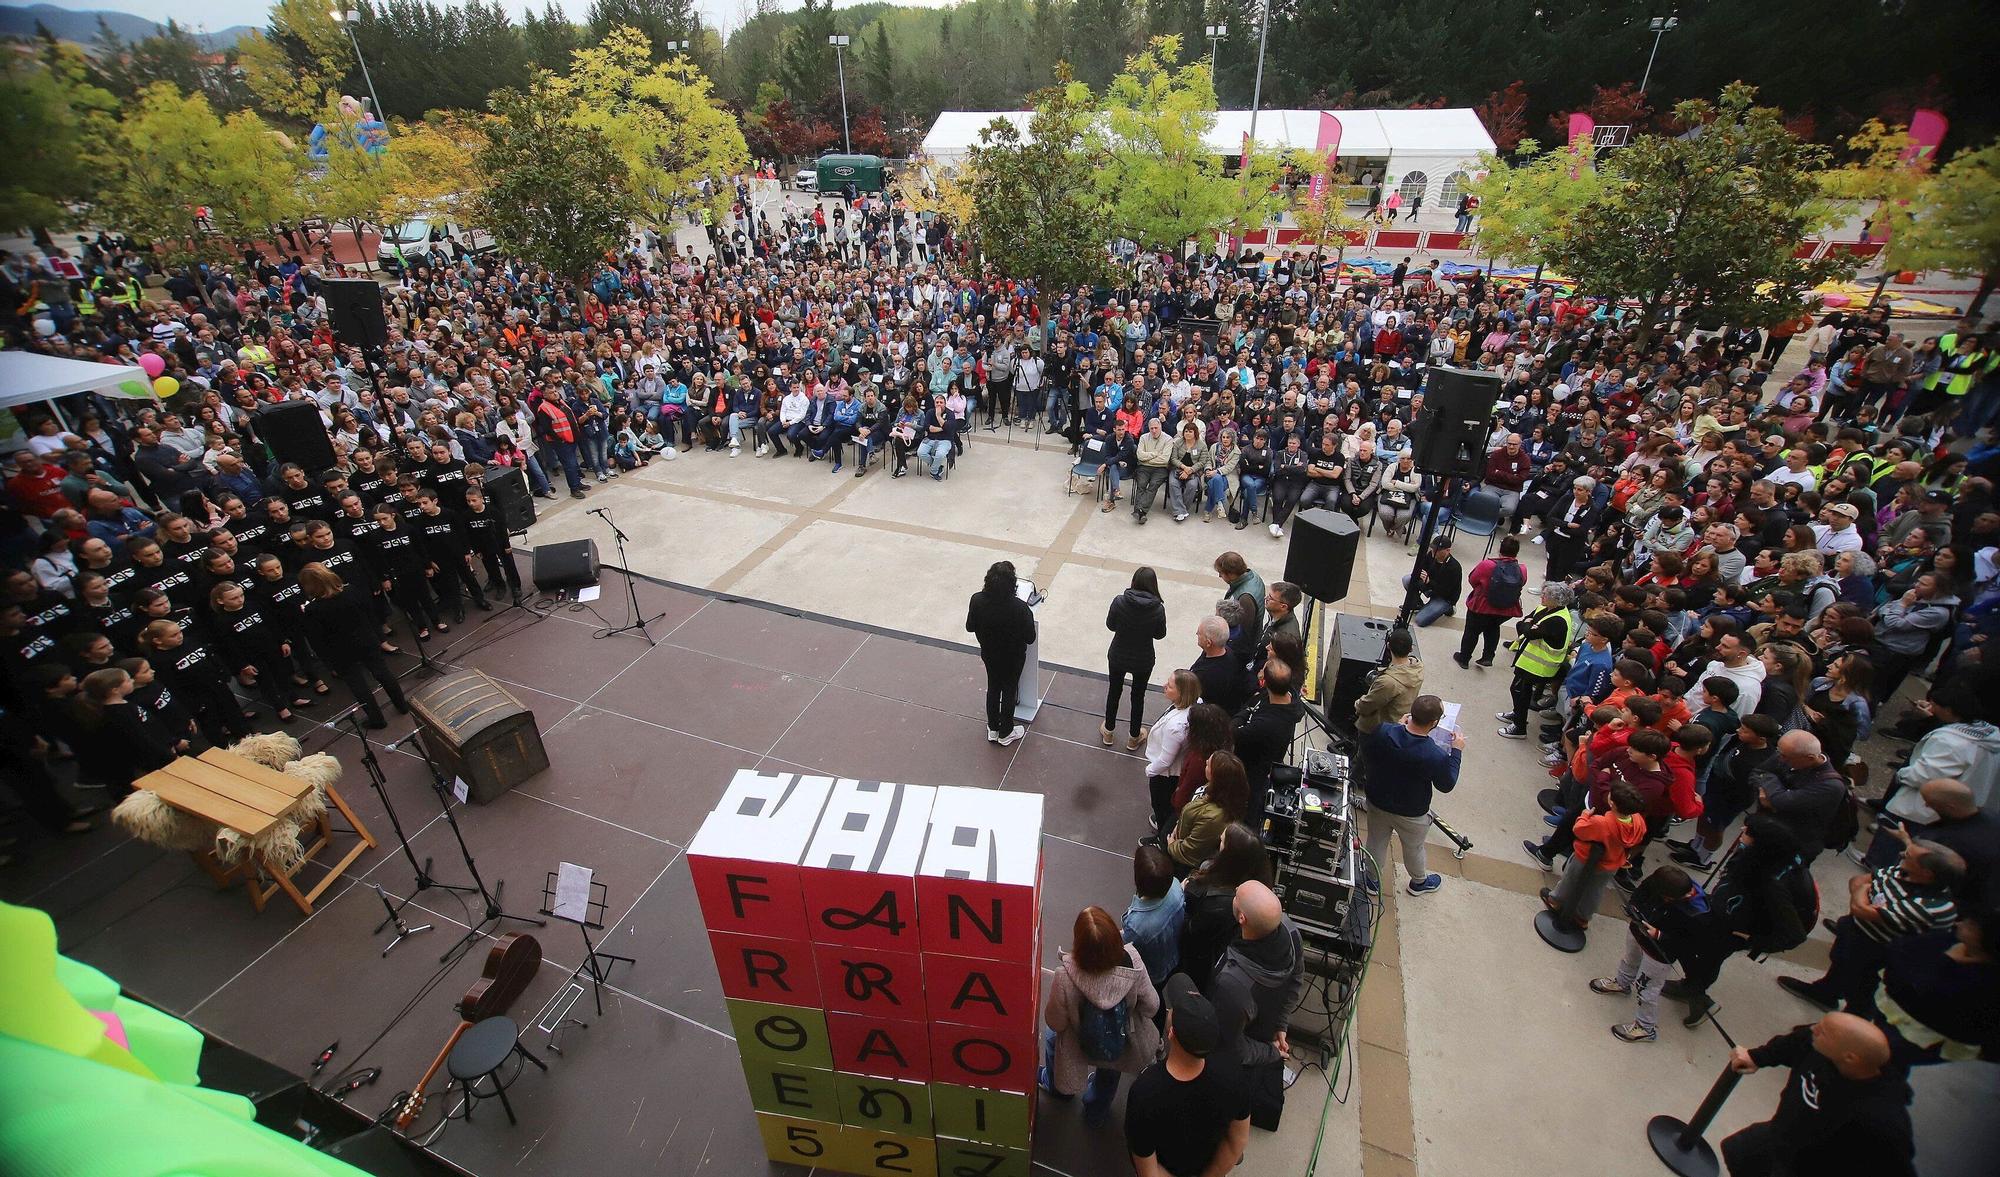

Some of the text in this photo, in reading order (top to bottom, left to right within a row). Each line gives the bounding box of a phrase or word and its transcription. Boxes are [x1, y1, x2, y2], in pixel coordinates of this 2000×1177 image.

[726, 874, 1003, 945] F A N
[741, 948, 1009, 1017] R R A
[755, 1015, 1011, 1077] O A O
[771, 1072, 813, 1109] E
[786, 1126, 824, 1158] 5
[874, 1140, 913, 1174] 2
